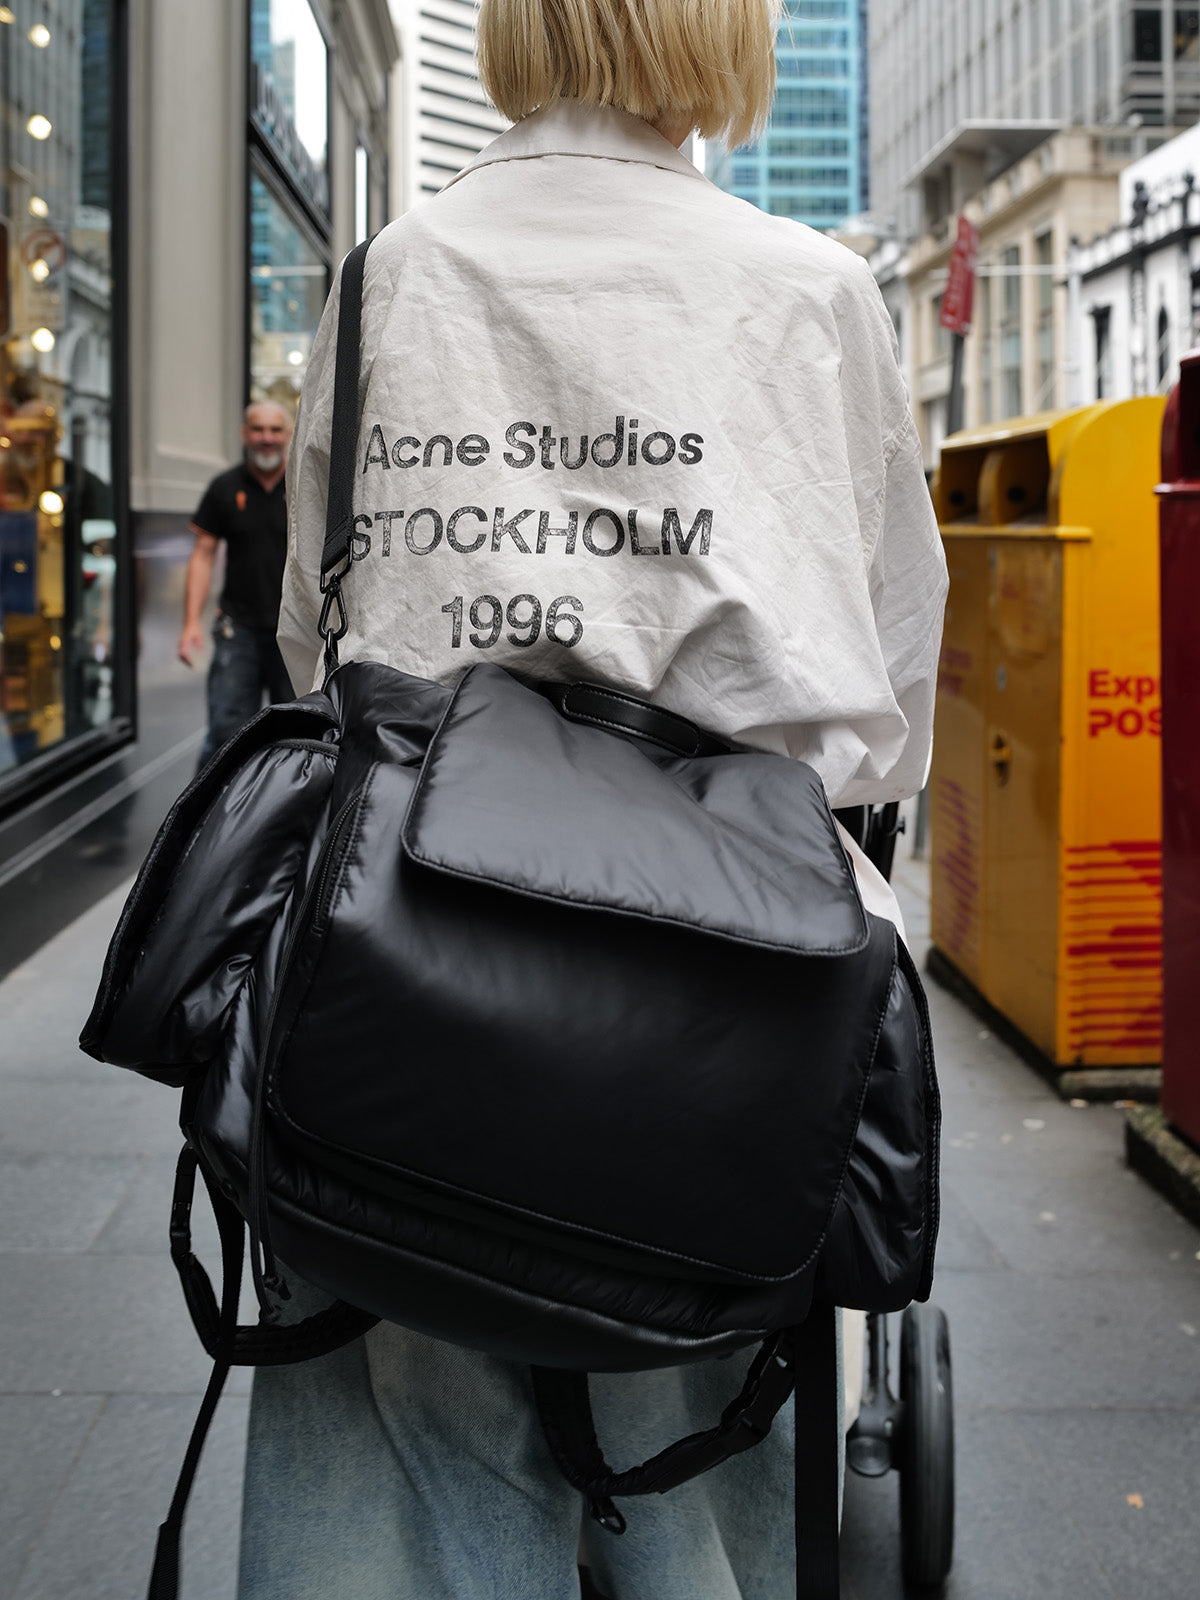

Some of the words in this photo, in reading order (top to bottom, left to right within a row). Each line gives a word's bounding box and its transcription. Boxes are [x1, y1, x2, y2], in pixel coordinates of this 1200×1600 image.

[363, 424, 490, 473] Acne
[503, 416, 704, 470] Studios
[350, 506, 713, 561] STOCKHOLM
[441, 594, 584, 649] 1996
